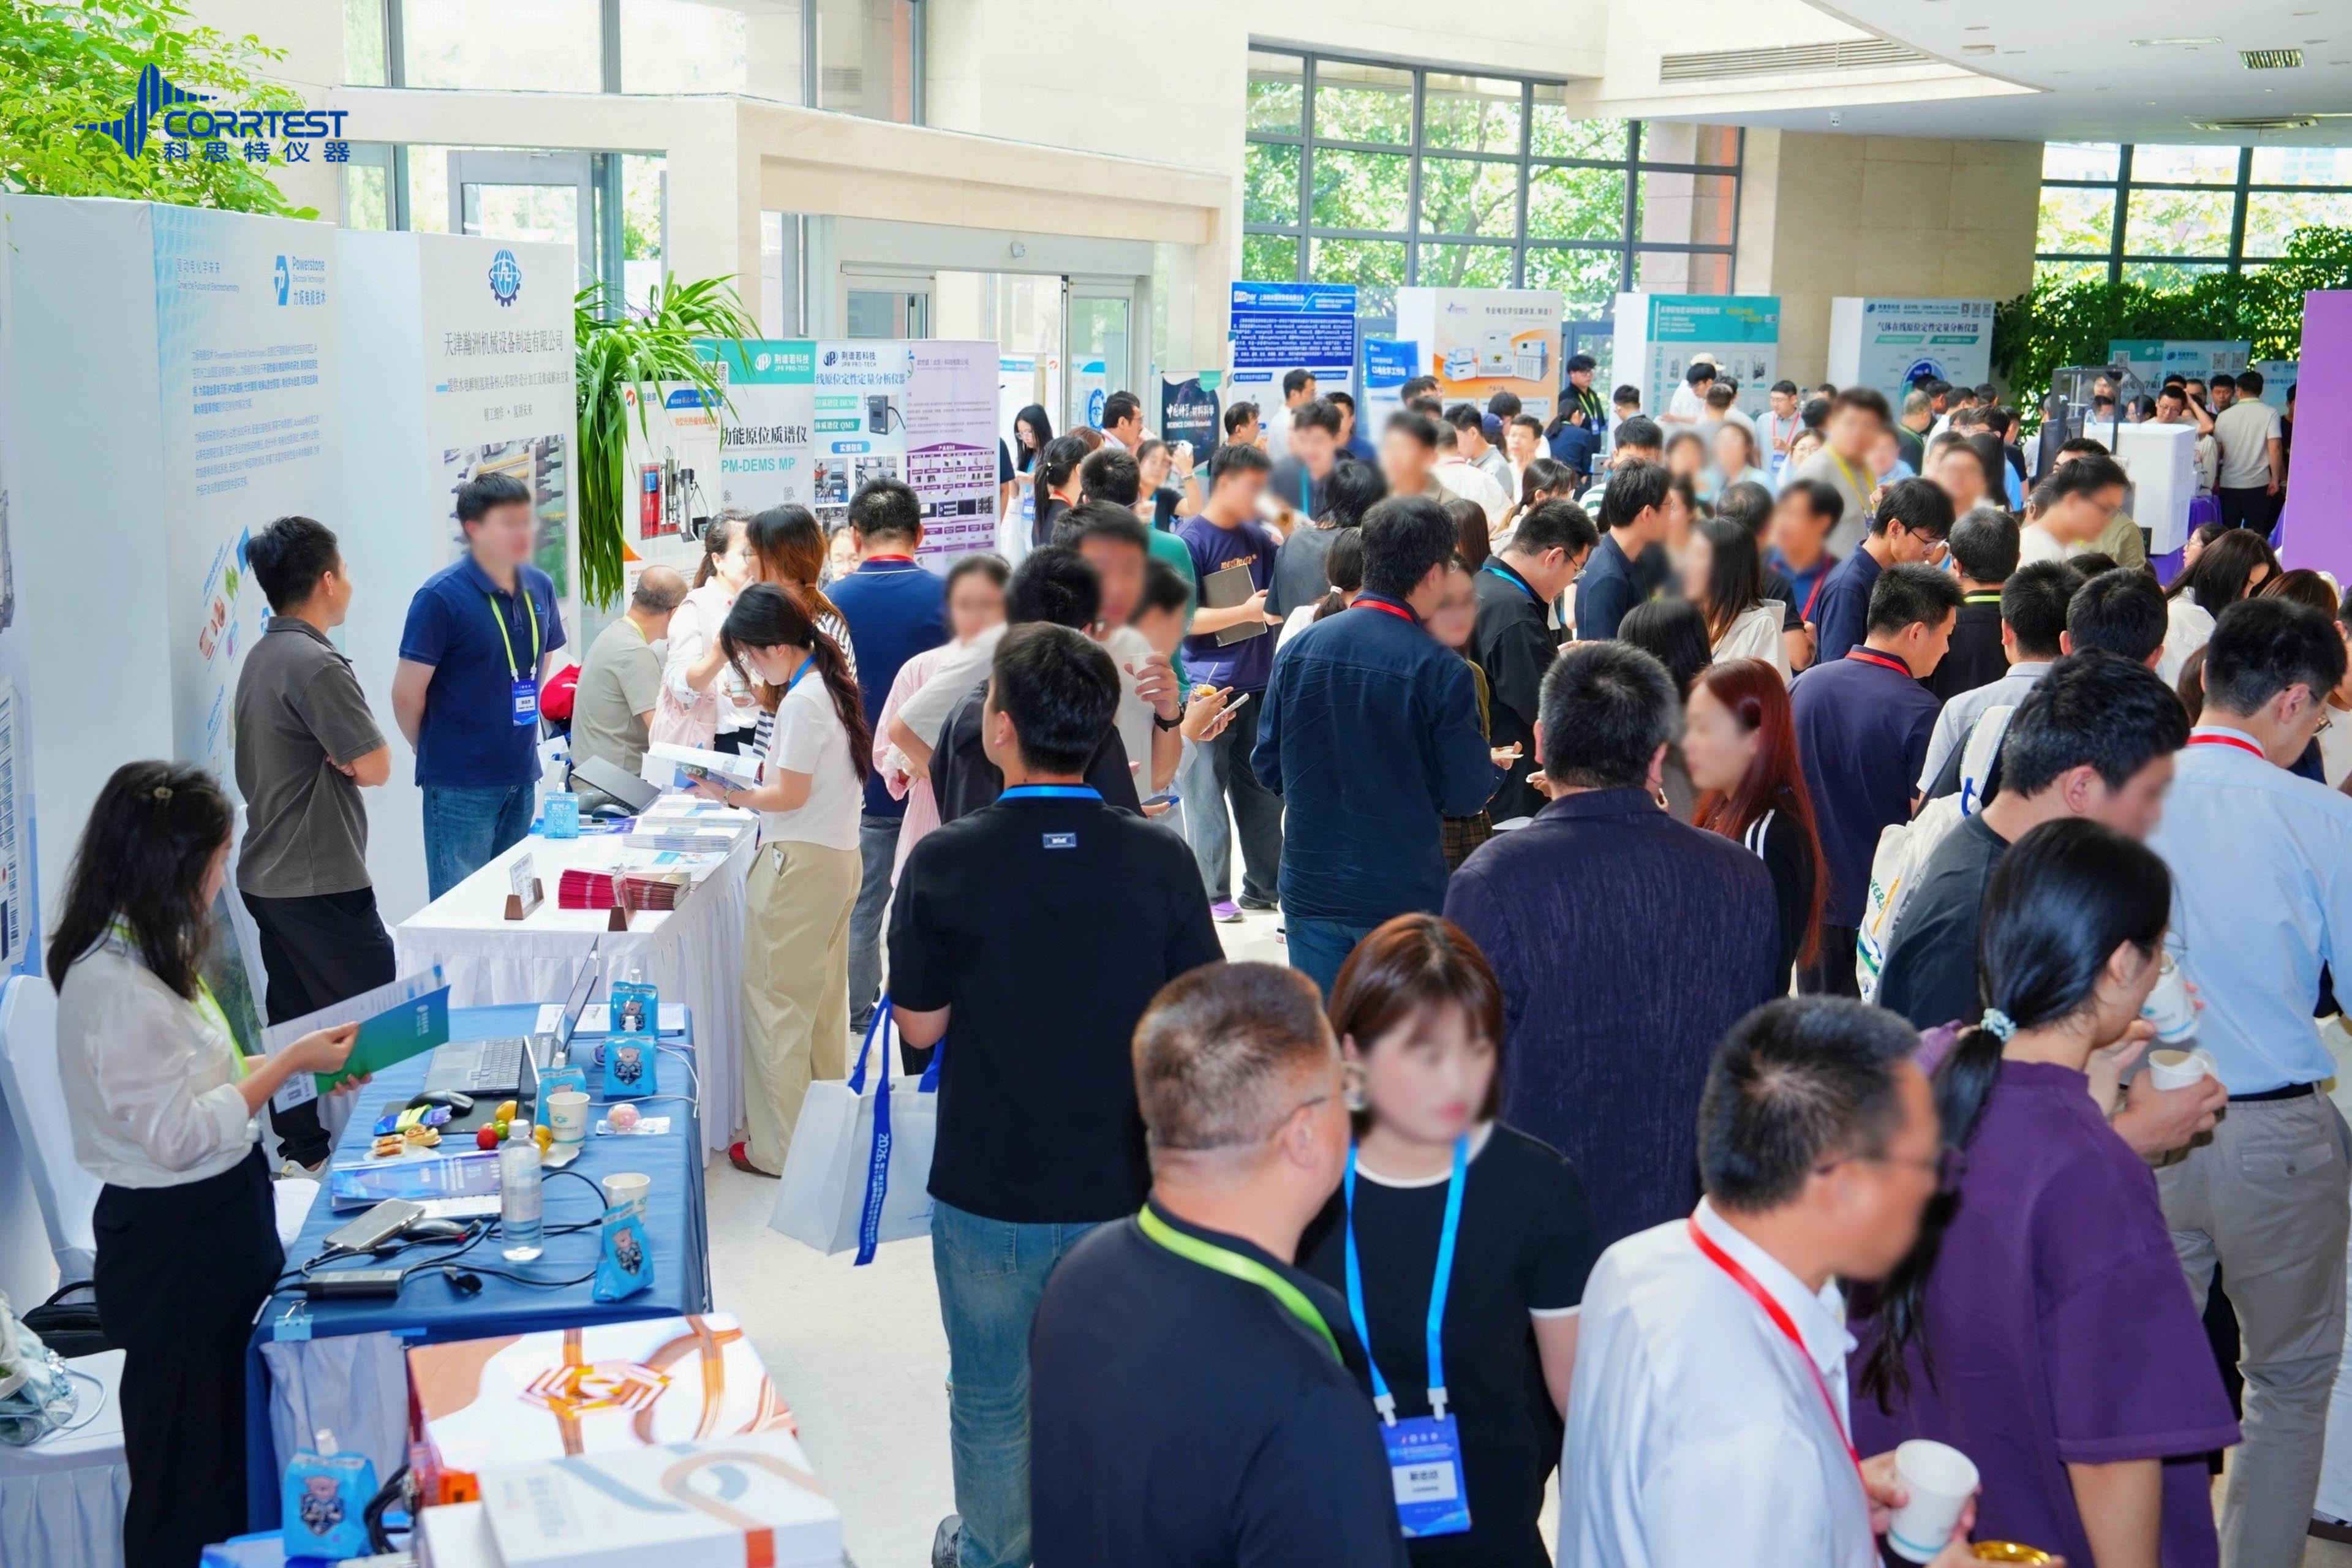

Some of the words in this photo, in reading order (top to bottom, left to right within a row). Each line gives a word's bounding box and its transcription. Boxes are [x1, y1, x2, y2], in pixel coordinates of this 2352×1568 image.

[292, 256, 325, 271] Powerstone
[444, 329, 563, 356] 天津瀚洲机械设备制造有限公司
[816, 373, 905, 385] 线原位定性定量分析仪器
[841, 421, 854, 431] QMS
[722, 458, 775, 473] PM-DEMS
[778, 457, 795, 470] MP
